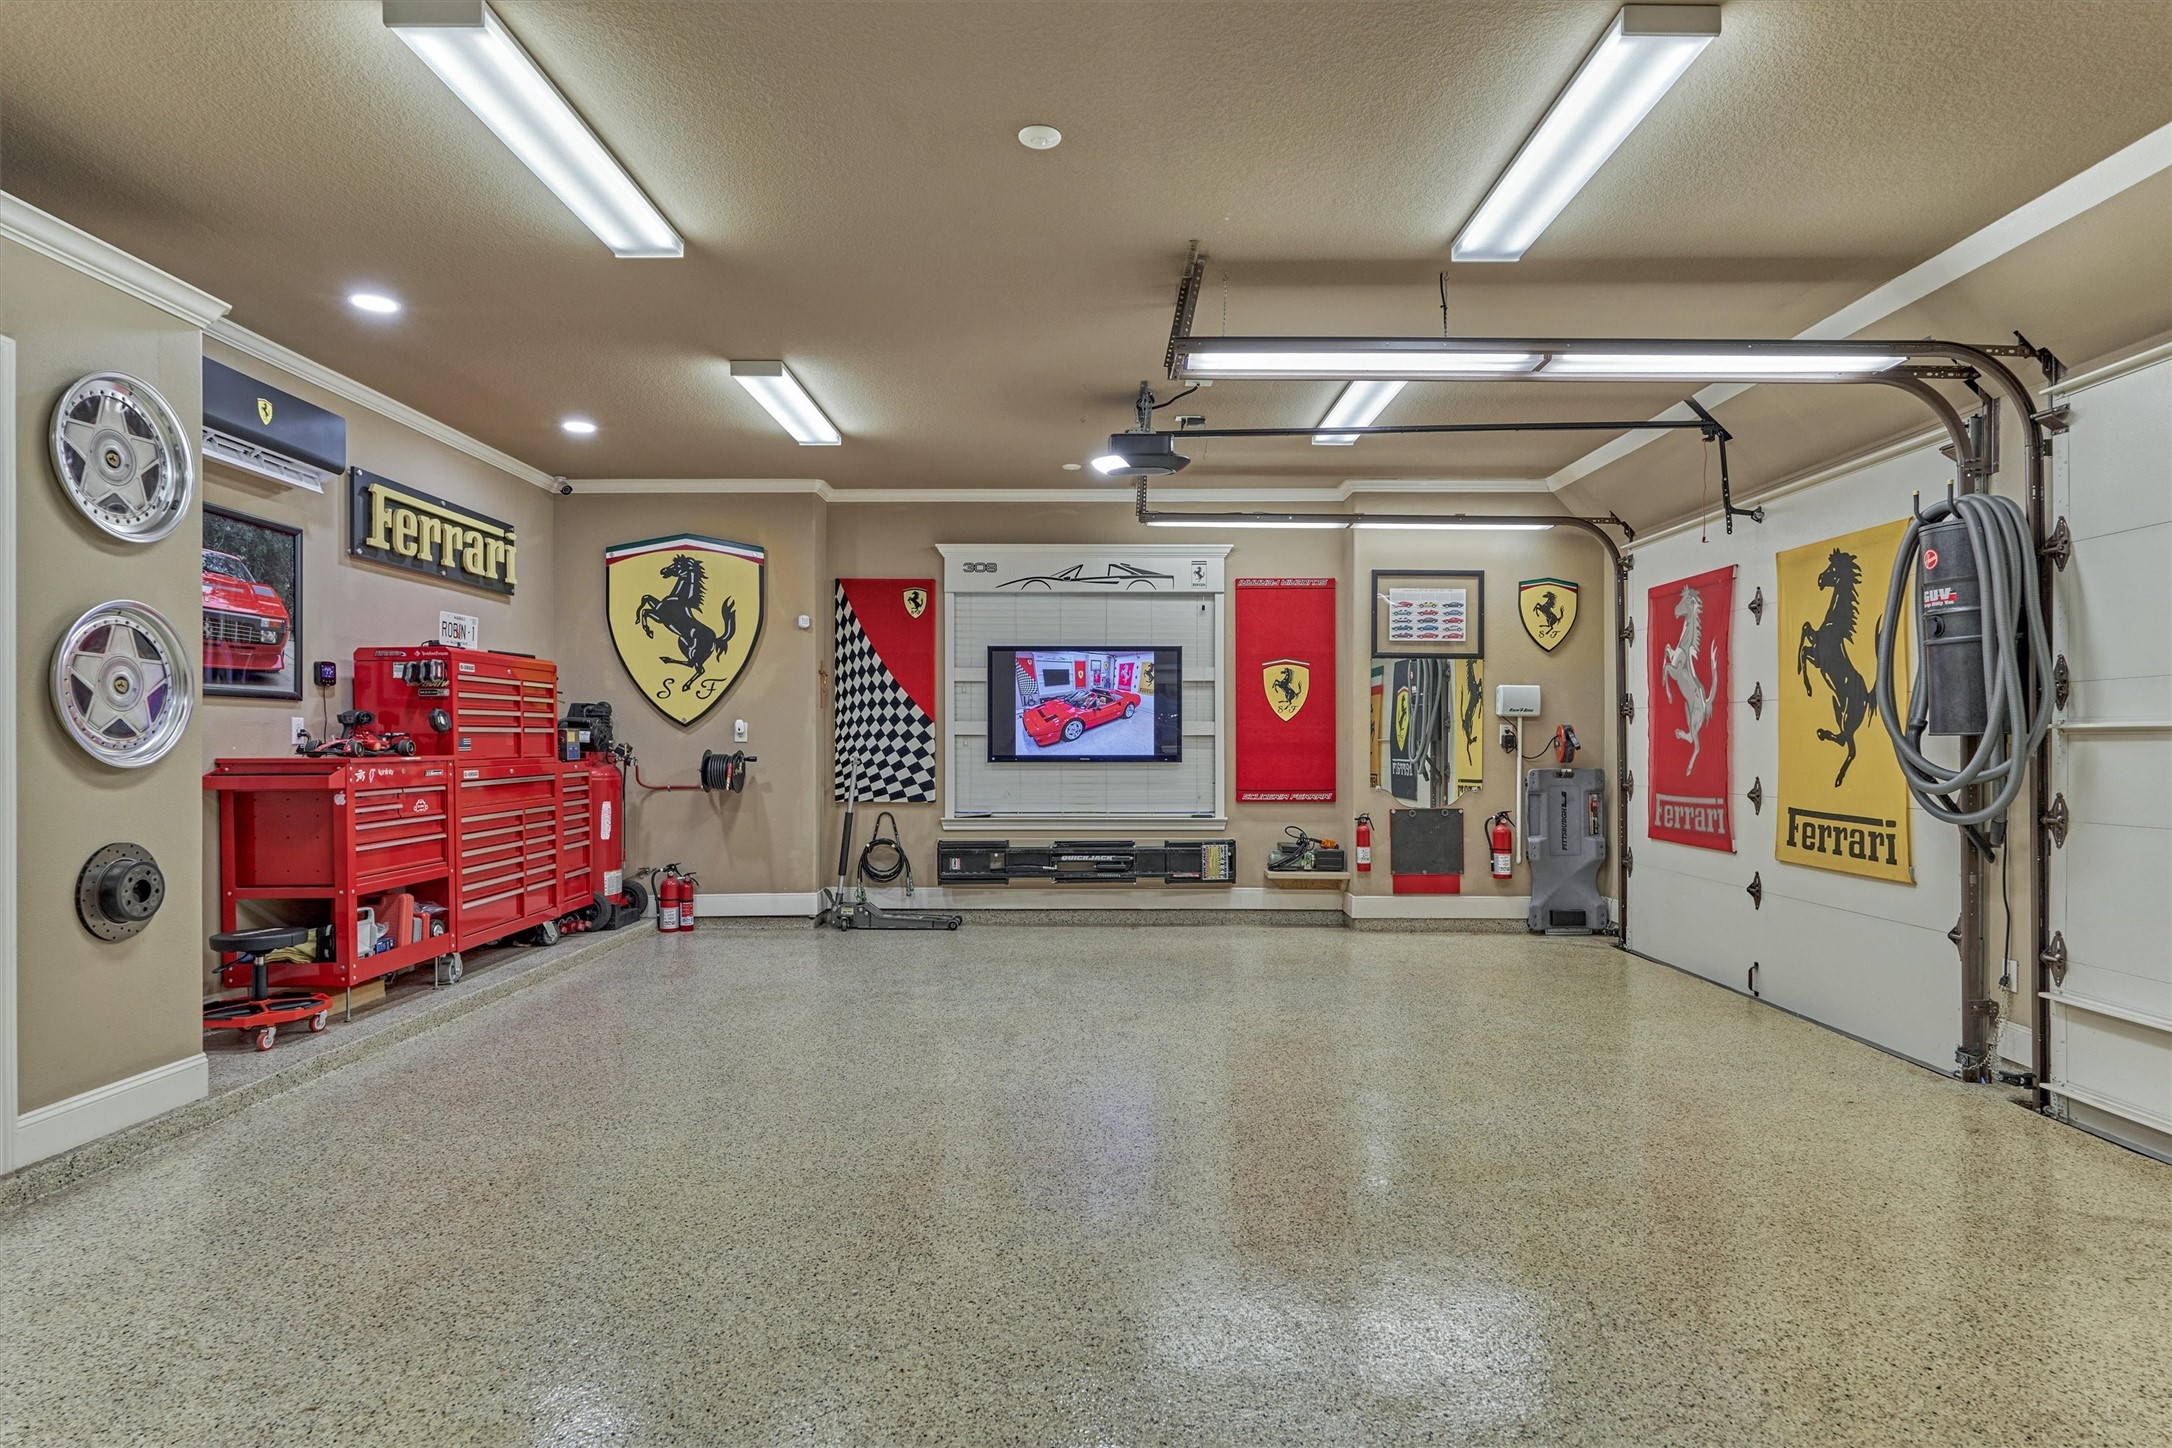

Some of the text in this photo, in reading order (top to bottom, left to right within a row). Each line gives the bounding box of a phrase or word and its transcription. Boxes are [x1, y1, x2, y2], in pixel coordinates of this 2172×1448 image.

[366, 483, 517, 584] Ferrari
[962, 562, 998, 573] 308
[656, 677, 727, 700] S F
[1654, 793, 1725, 834] Ferrari
[1786, 807, 1897, 865] Ferrari
